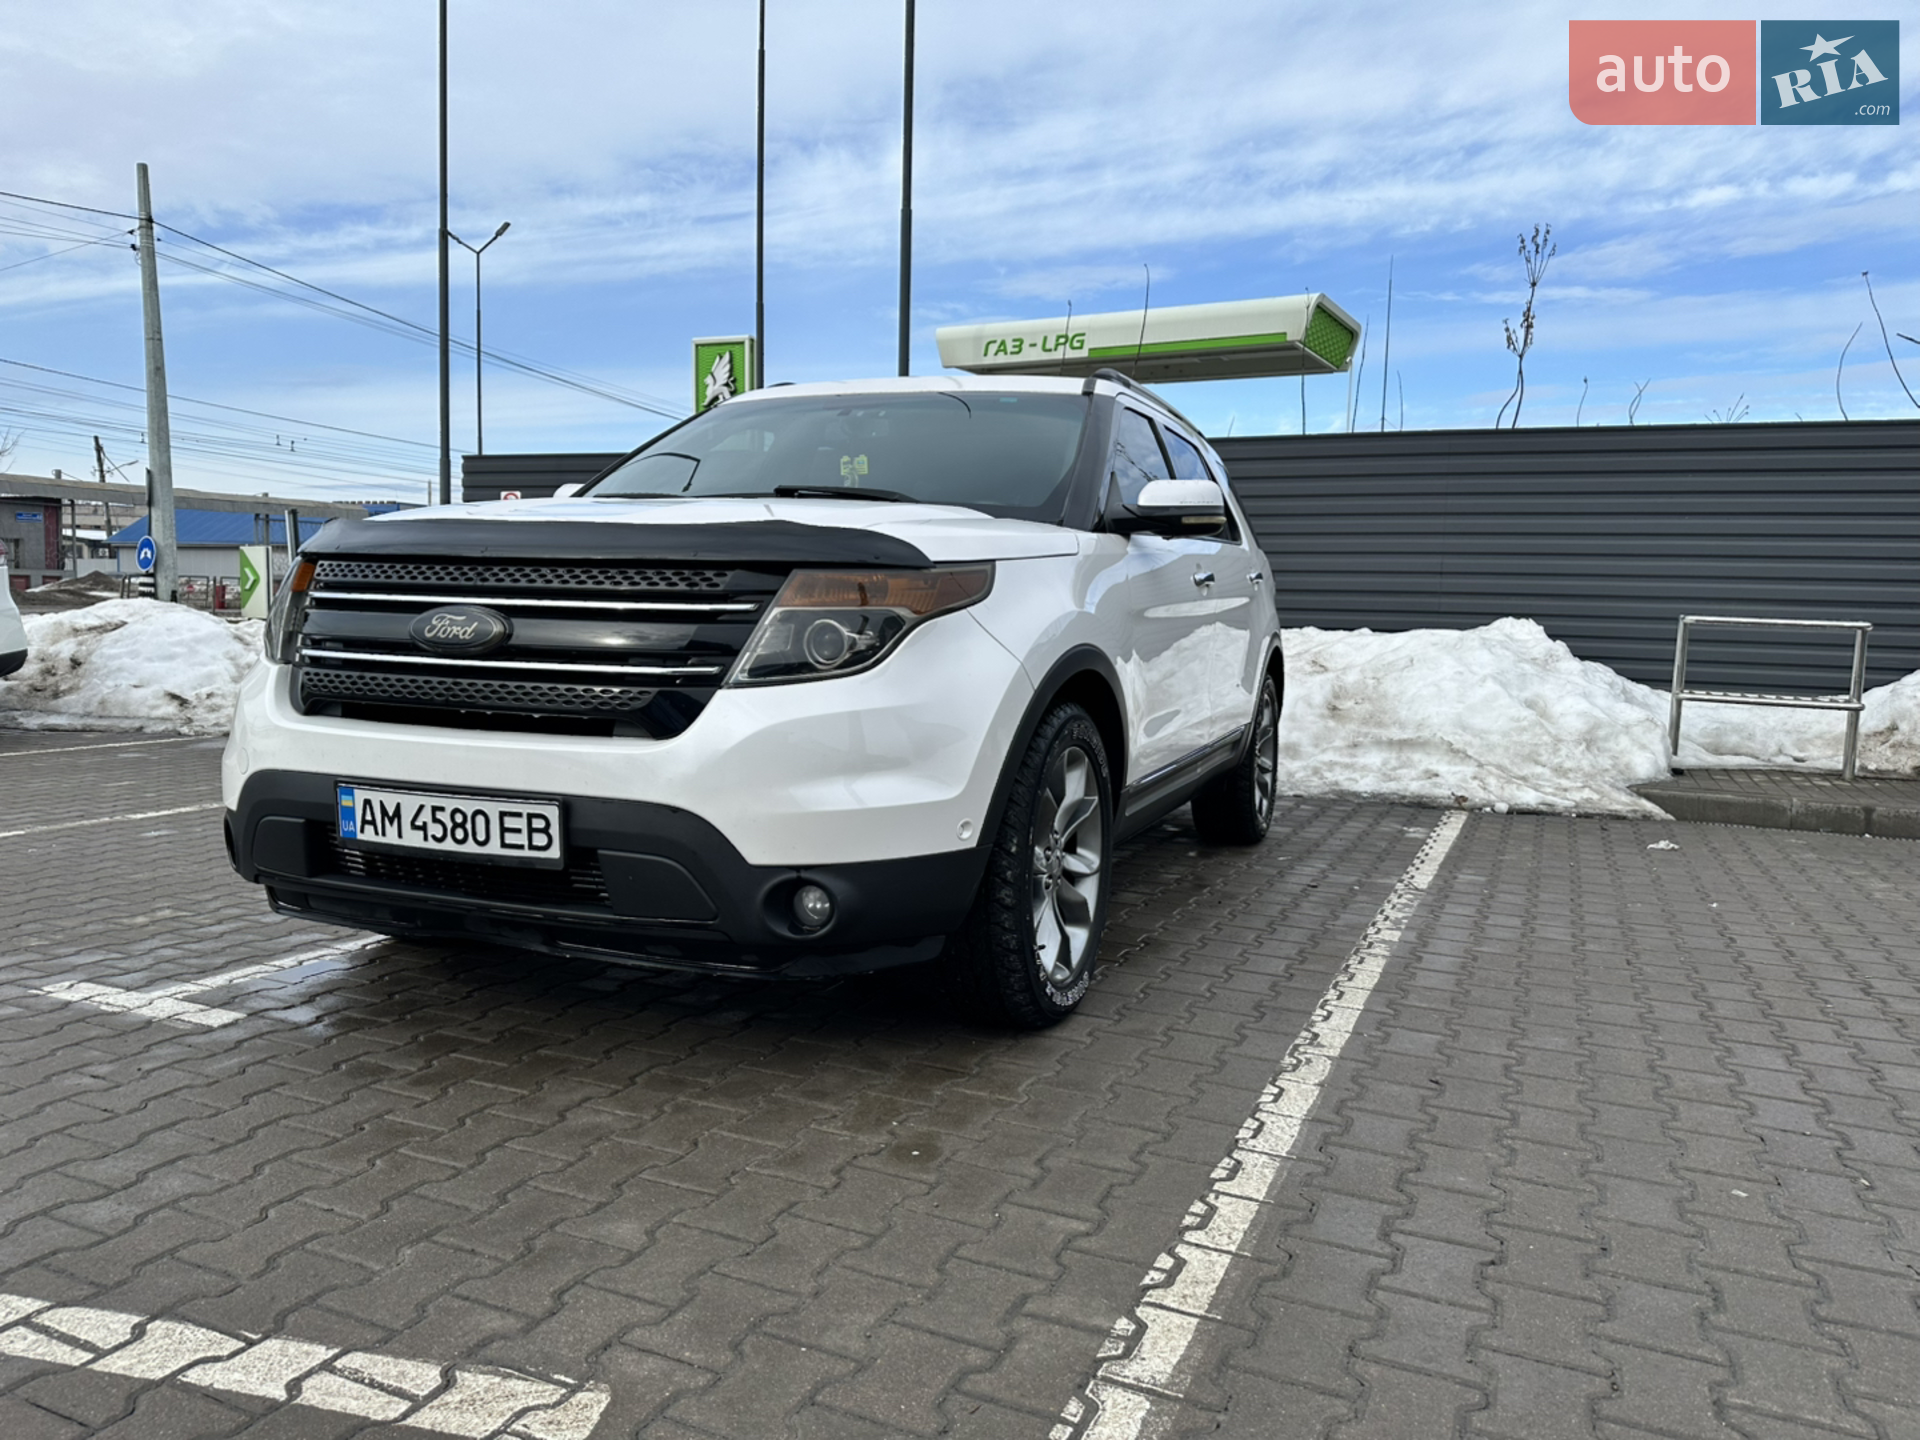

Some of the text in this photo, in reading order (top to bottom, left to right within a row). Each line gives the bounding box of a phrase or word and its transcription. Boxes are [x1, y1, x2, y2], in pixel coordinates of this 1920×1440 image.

[424, 612, 479, 640] Ford
[342, 820, 356, 833] UA
[359, 797, 554, 852] AM 4580 EB
